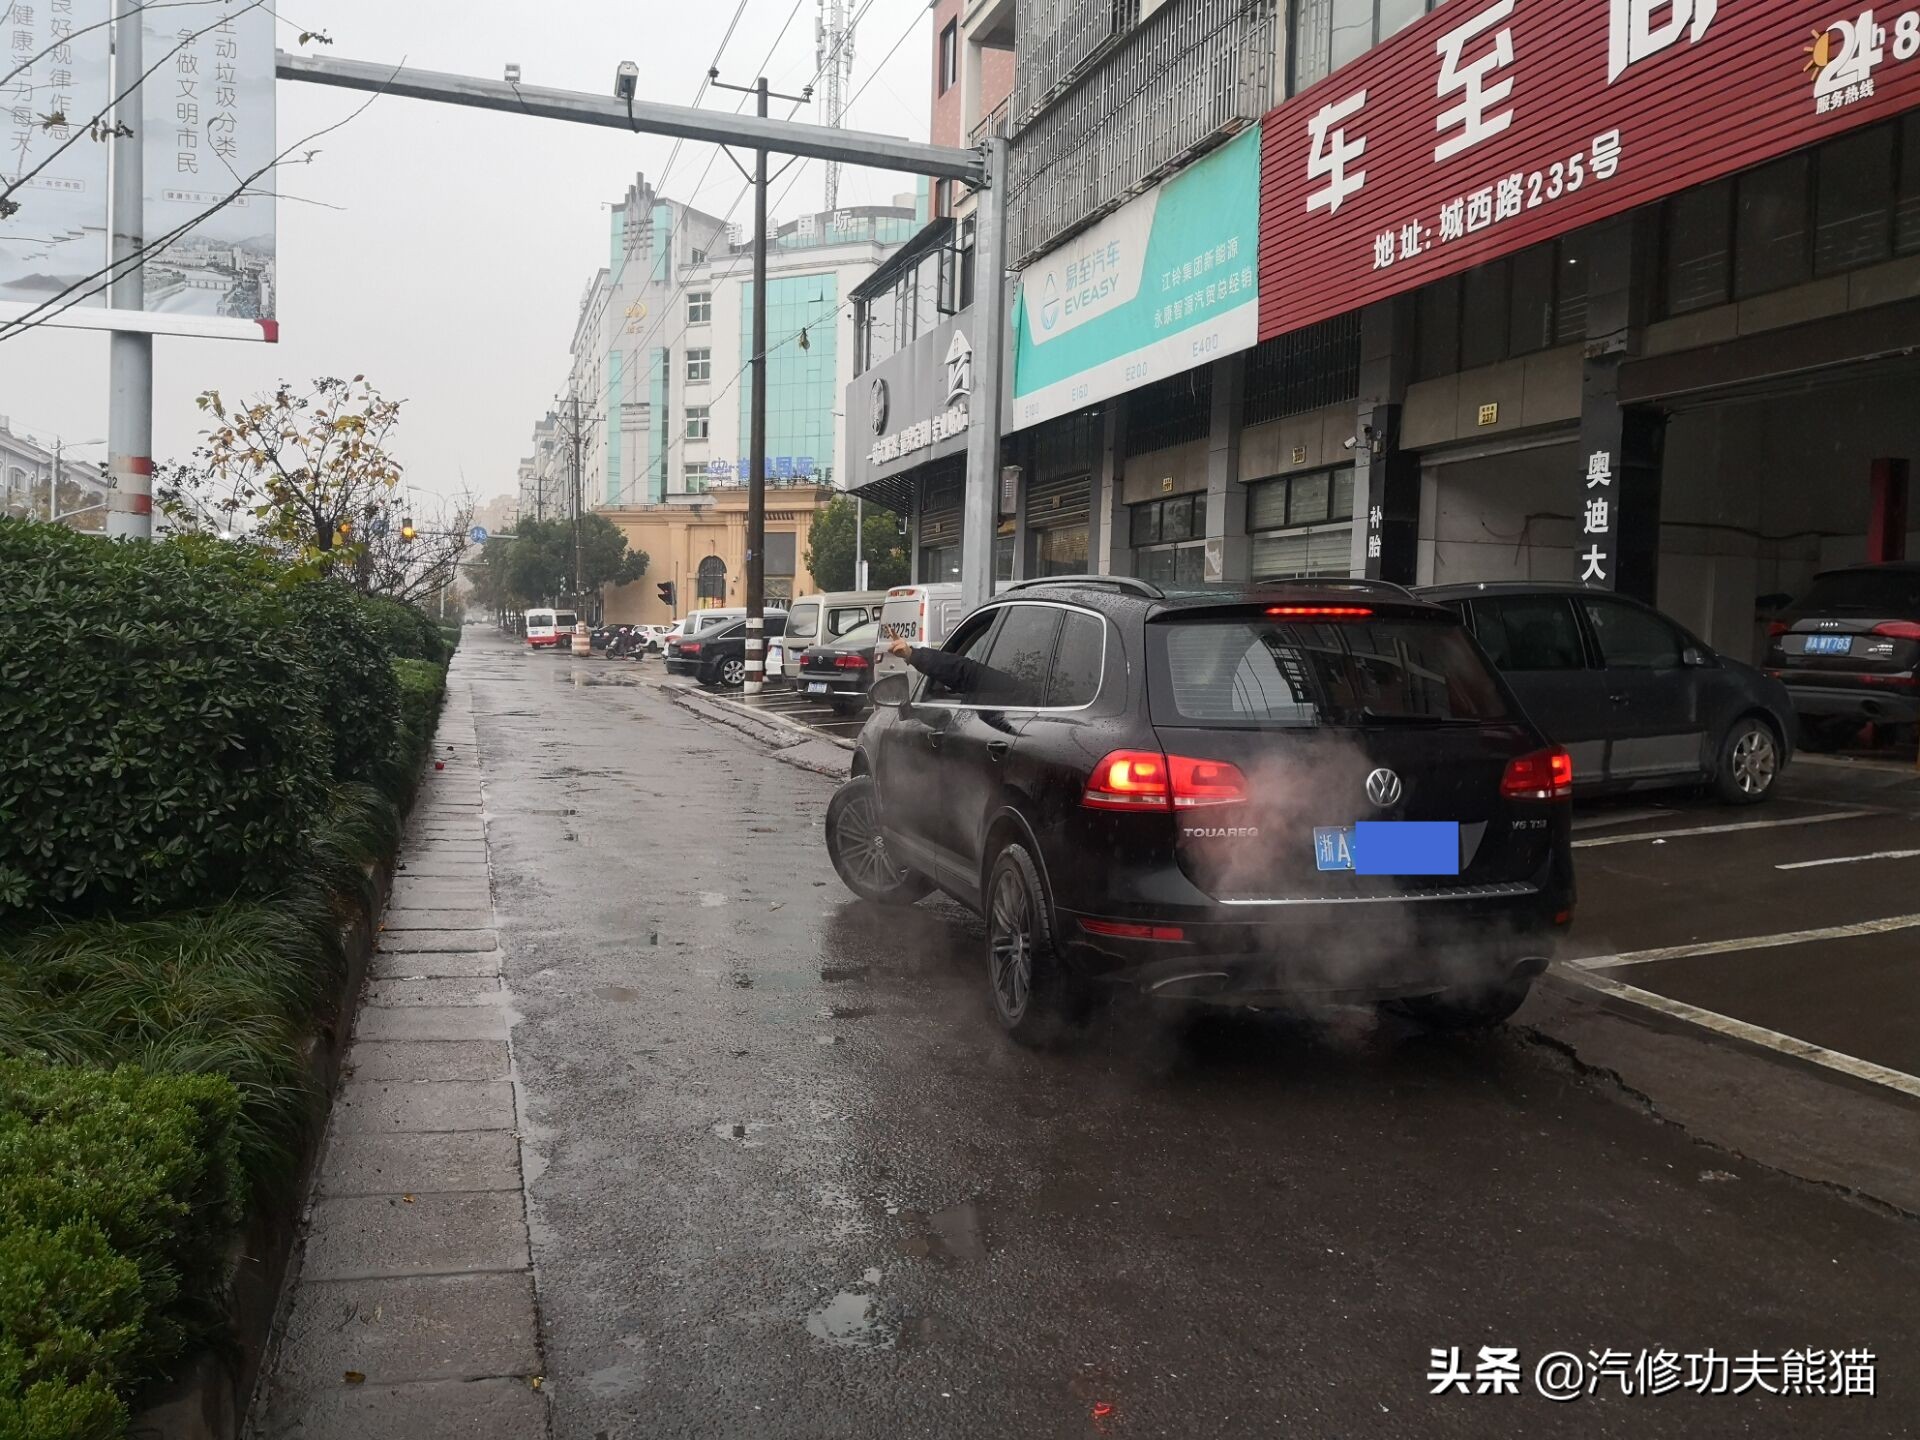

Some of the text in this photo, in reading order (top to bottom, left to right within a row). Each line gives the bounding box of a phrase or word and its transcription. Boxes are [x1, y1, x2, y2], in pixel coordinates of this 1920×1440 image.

[176, 28, 199, 175] 争做文明市民
[214, 14, 237, 159] 主动垃圾分类
[1816, 79, 1875, 115] 服务热线
[1065, 239, 1121, 292] 易至汽车
[1161, 235, 1239, 292] 江铃集团新能源
[1064, 273, 1120, 315] EVEASY
[1192, 333, 1219, 358] E400
[1126, 362, 1148, 381] E200
[1368, 504, 1383, 558] 补胎
[1183, 827, 1259, 838] TOUAREG
